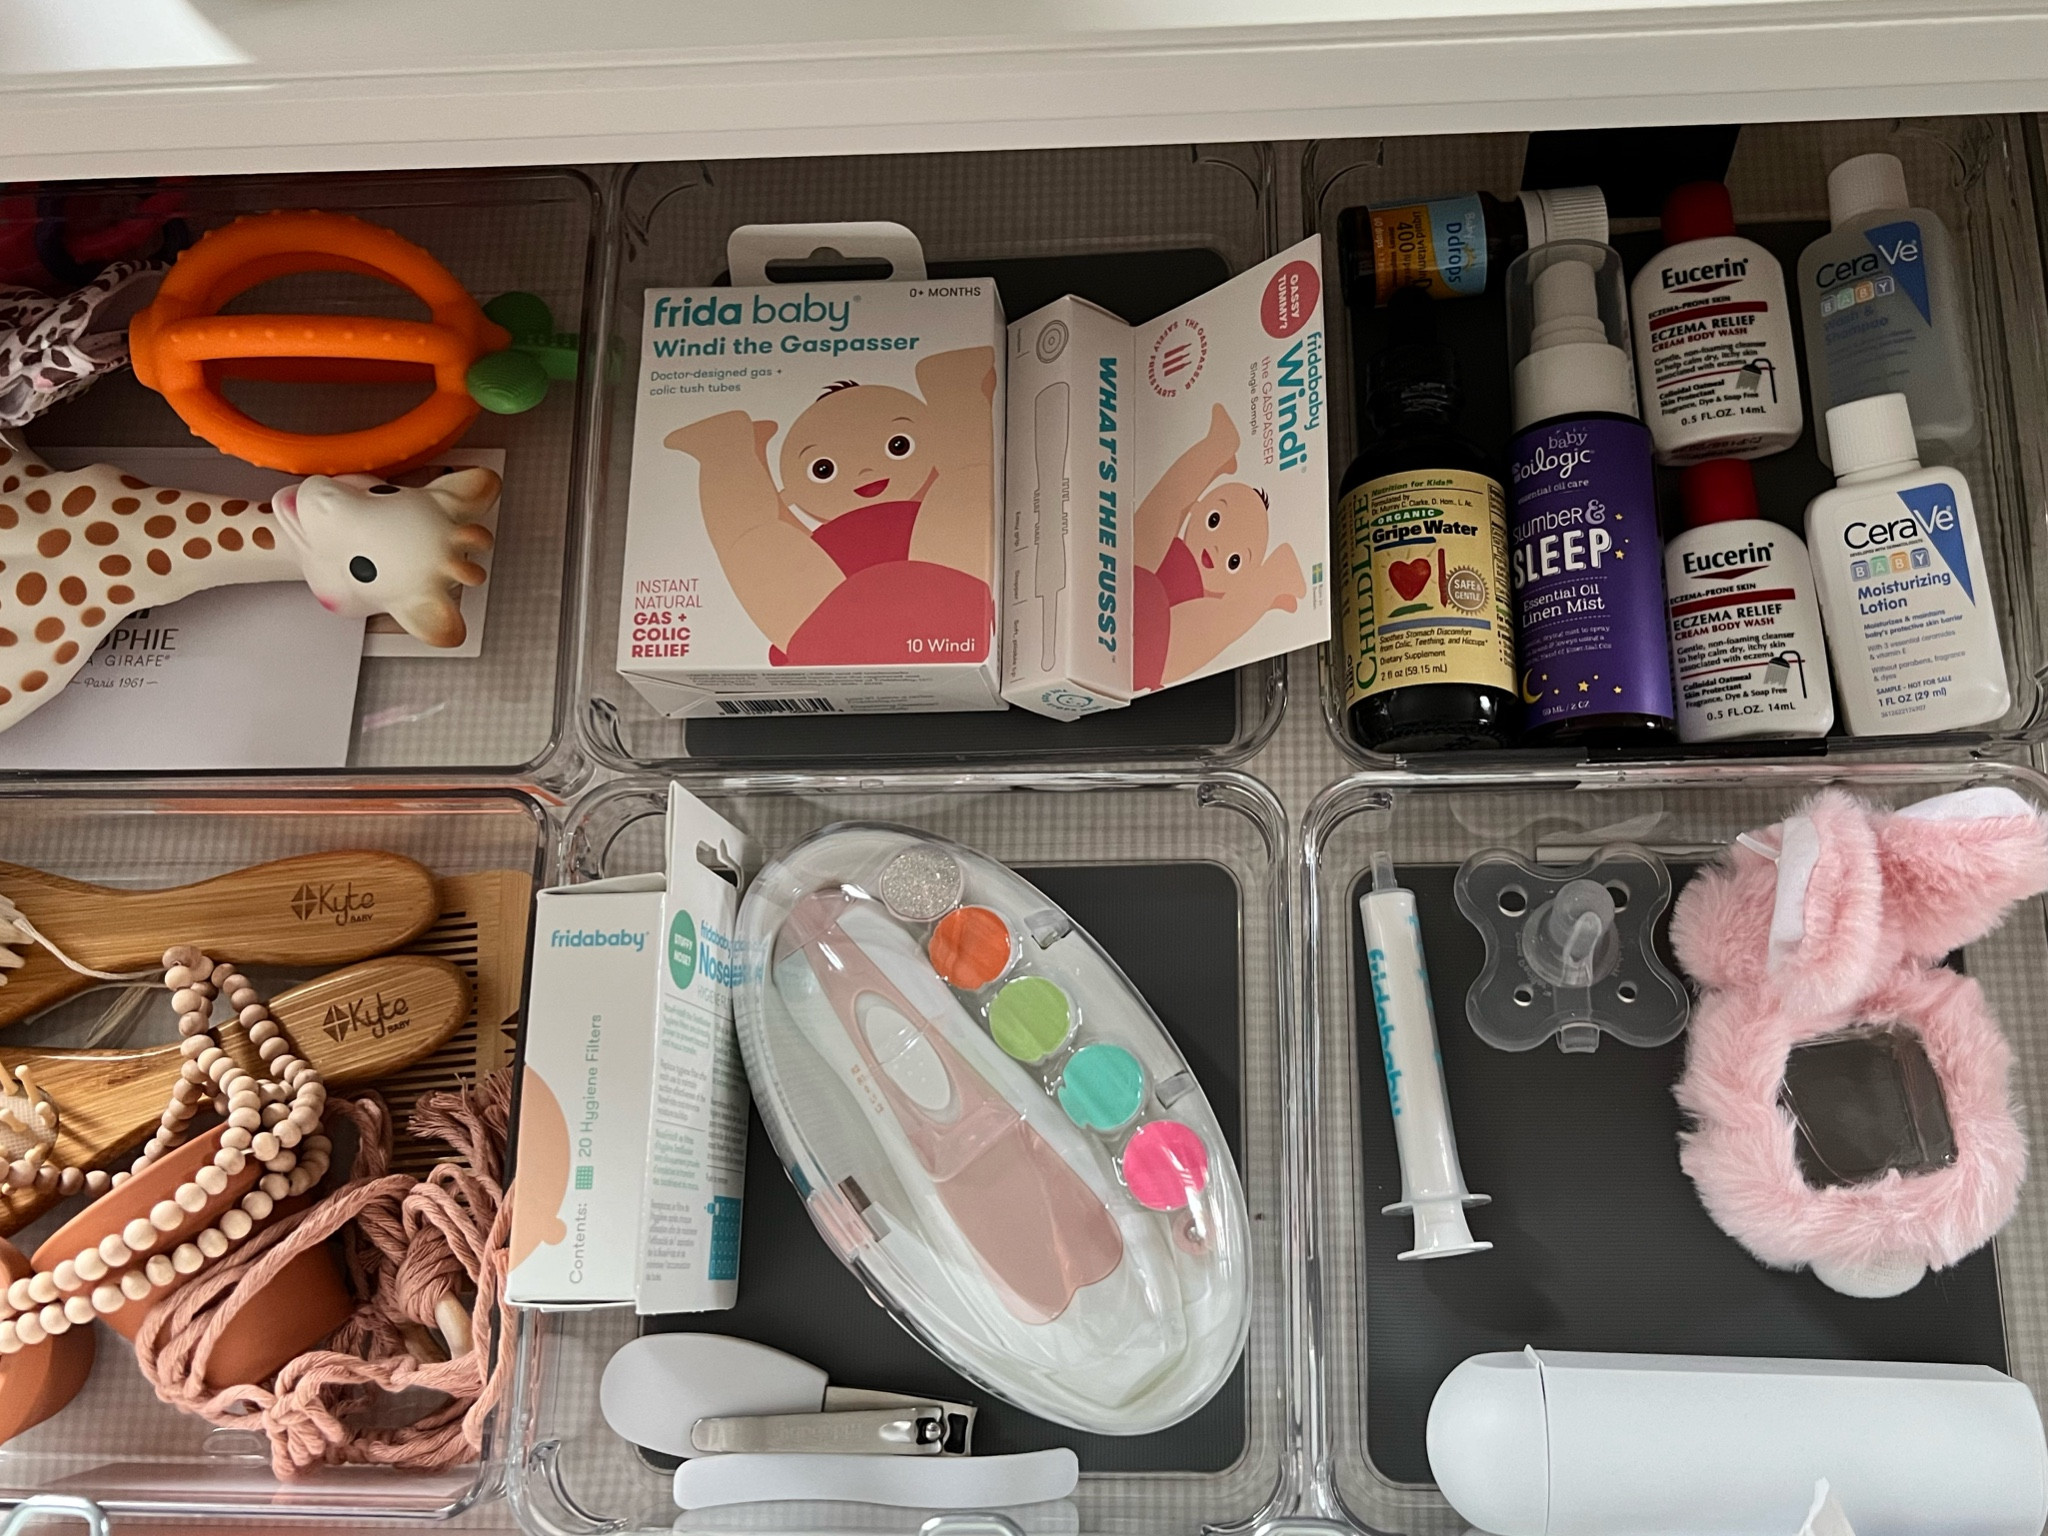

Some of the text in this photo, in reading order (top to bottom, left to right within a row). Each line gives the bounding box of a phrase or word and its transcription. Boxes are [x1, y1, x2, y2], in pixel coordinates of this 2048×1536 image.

[1397, 221, 1416, 254] 400
[1416, 238, 1431, 279] vitamin
[1446, 222, 1465, 284] Ddrops
[1816, 239, 1918, 289] CeraVe
[1661, 257, 1747, 290] Eucerin
[909, 286, 981, 298] 0+ MONTHS
[1712, 296, 1731, 304] SKIN
[1822, 279, 1892, 315] BABY
[653, 293, 850, 332] frida baby
[1651, 314, 1756, 345] ECZEMA RELIEF
[1651, 327, 1748, 354] CREAM BODY WASH
[653, 334, 920, 358] Windi the Gaspasser
[650, 367, 748, 382] Doctor-designed
[750, 369, 773, 380] gas
[1304, 331, 1323, 431] fridababy
[649, 382, 741, 397] colic tush tubes
[1249, 362, 1259, 436] Single Sample
[1261, 356, 1274, 466] the GASPASSER
[1277, 339, 1307, 472] Windi
[1681, 405, 1767, 427] 0.5 FL.OZ. 14mL
[1548, 431, 1588, 450] baby
[1520, 446, 1591, 479] oilogic
[1410, 480, 1423, 488] for
[1567, 478, 1590, 489] care
[1097, 357, 1117, 653] WHAT'S THE FUSS?
[1377, 509, 1435, 525] ORGANIC
[1585, 499, 1606, 525] &
[1371, 519, 1479, 545] Gripe Water
[1843, 505, 1954, 550] CeraVe
[1513, 527, 1613, 590] SLEEP
[1682, 541, 1774, 575] Eucerin
[1852, 550, 1929, 580] BABY
[635, 578, 699, 595] INSTANT
[1454, 580, 1476, 590] SAFE
[1669, 582, 1757, 605] ECZEMA-PRONE SKIN
[1857, 572, 1952, 601] Moisturizing
[634, 594, 703, 611] NATURAL
[1522, 583, 1600, 613] Essential Oil
[1860, 596, 1908, 616] Lotion
[633, 611, 688, 626] GAS +
[1521, 596, 1606, 629] Linen Mist
[1672, 603, 1784, 632] ECZEMA RELIEF
[1863, 608, 1947, 631] Moisturizes & maintains
[631, 627, 691, 643] COLIC
[1405, 628, 1435, 639] Stomach
[1436, 627, 1472, 637] Discomfort
[1674, 616, 1775, 642] CREAM BODY WASH
[1864, 613, 1963, 640] baby's protective skin barrier
[94, 627, 180, 652] PHIE
[631, 643, 690, 659] RELIEF
[905, 637, 976, 654] 10 Windi
[1676, 631, 1796, 656] Gentle, non-foaming cleanser
[1678, 639, 1786, 664] to help calm dry, itchy skin
[104, 654, 164, 668] GIRAFE
[1380, 650, 1446, 667] Dietary Supplement
[1679, 651, 1775, 673] associated with eczema
[84, 677, 145, 689] Paris 1961
[1381, 672, 1386, 681] 2
[1394, 670, 1404, 678] oz
[1405, 664, 1431, 678] (59.15
[1432, 663, 1448, 674] mL)
[1683, 678, 1717, 692] Colloidal
[1684, 682, 1742, 701] Skin Protectant
[1725, 691, 1741, 702] Dye
[1742, 690, 1749, 698] &
[1750, 686, 1770, 697] Soap
[1771, 687, 1788, 695] Free
[1876, 674, 1952, 695] SAMPLE NOT FOR SALE
[1879, 686, 1948, 708] 1 FL OZ (29 ml)
[1706, 702, 1796, 721] 0.5 FL.OZ. 14mL
[318, 882, 376, 927] Kyte
[350, 913, 374, 923] BABY
[551, 928, 647, 952] fridababy
[348, 992, 409, 1039] Kyte
[387, 1018, 412, 1034] BABY
[569, 1014, 602, 1285] Contents: 20 Hygiene Filters
